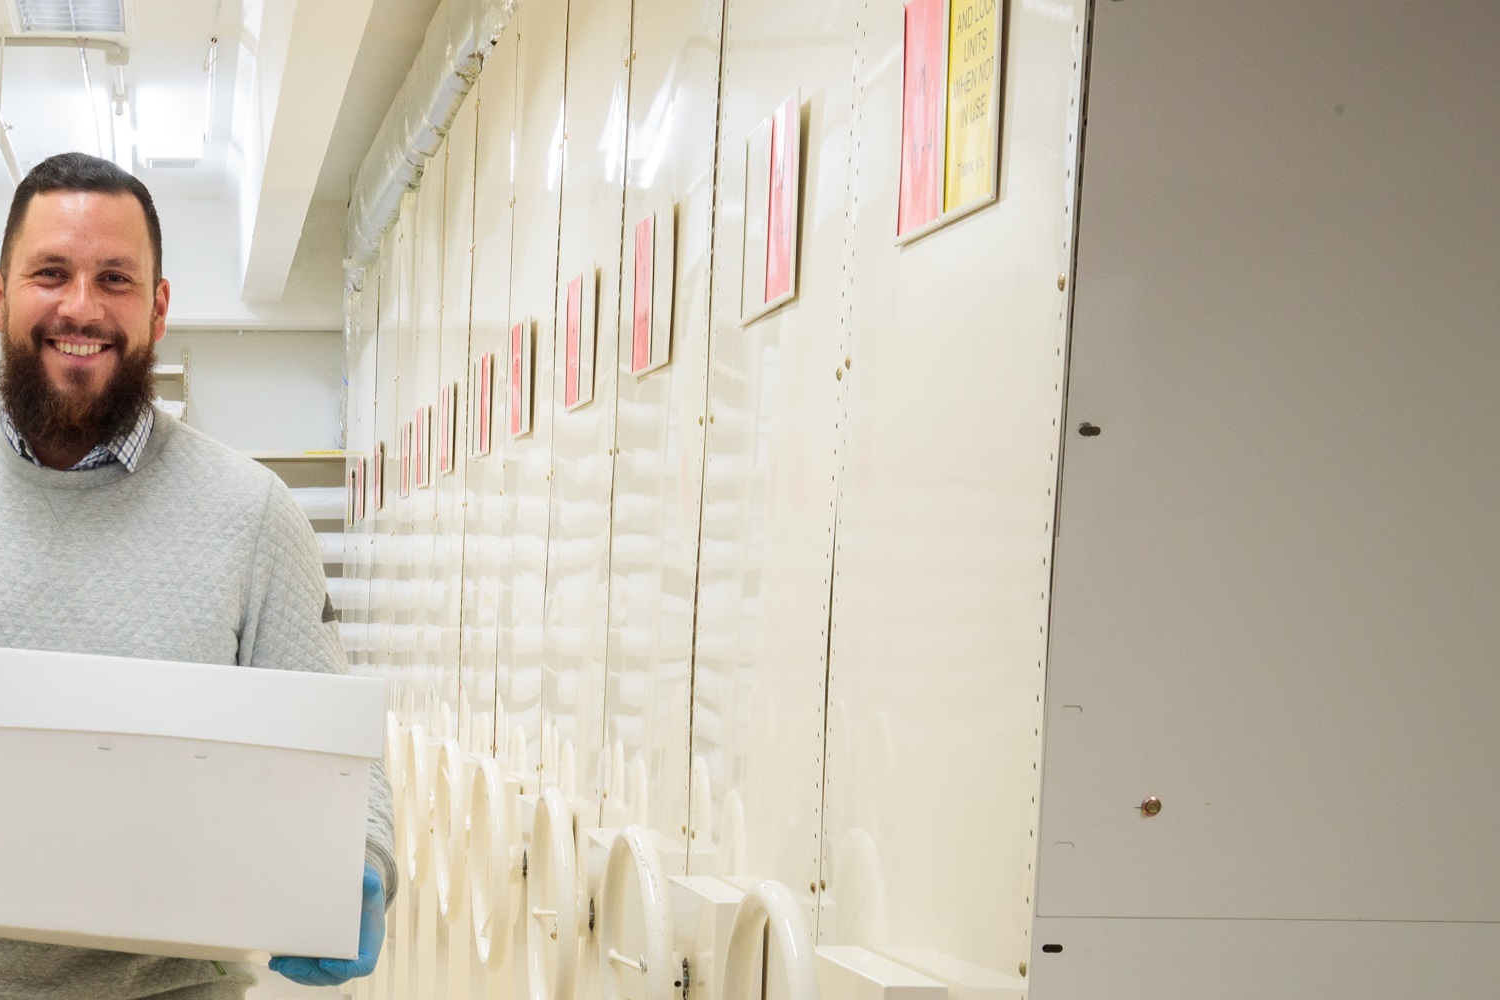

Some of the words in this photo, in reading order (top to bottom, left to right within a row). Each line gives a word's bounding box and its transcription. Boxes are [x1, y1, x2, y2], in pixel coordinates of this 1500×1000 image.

[957, 5, 974, 36] AND
[964, 27, 987, 62] UNITS
[953, 66, 977, 98] WHEN
[979, 55, 995, 86] NOT
[961, 103, 969, 127] IN
[971, 92, 986, 122] USE
